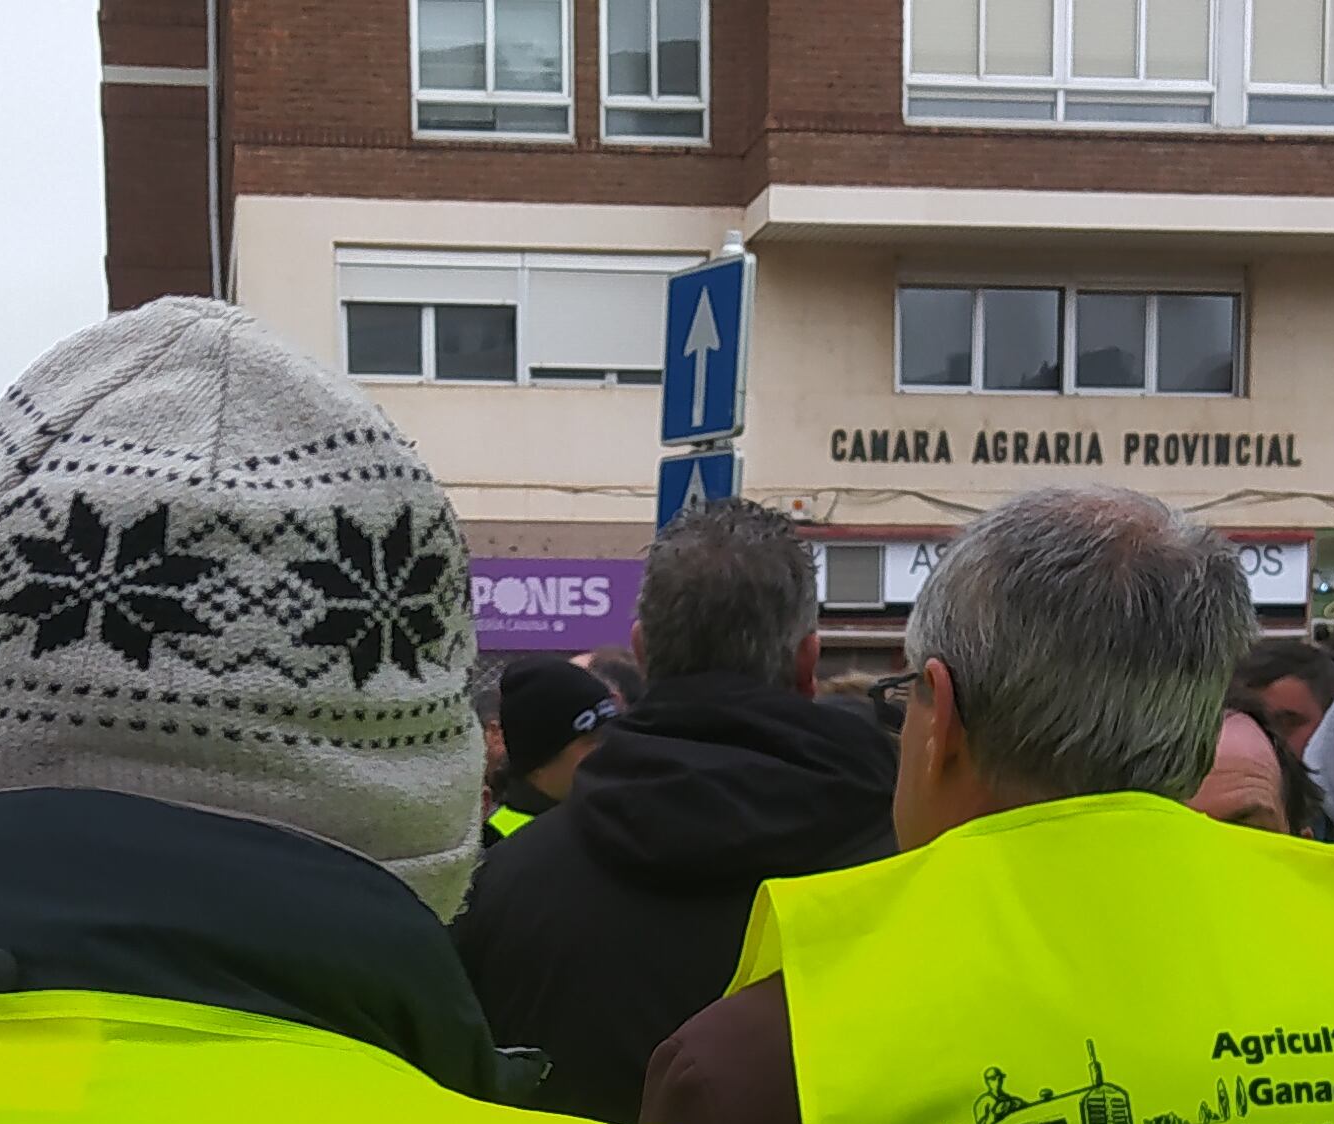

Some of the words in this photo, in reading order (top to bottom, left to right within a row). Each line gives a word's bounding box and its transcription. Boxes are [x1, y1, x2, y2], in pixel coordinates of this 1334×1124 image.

[830, 429, 953, 463] CAMARA
[971, 430, 1103, 465] AGRARIA
[1123, 432, 1302, 467] PROVINCIAL
